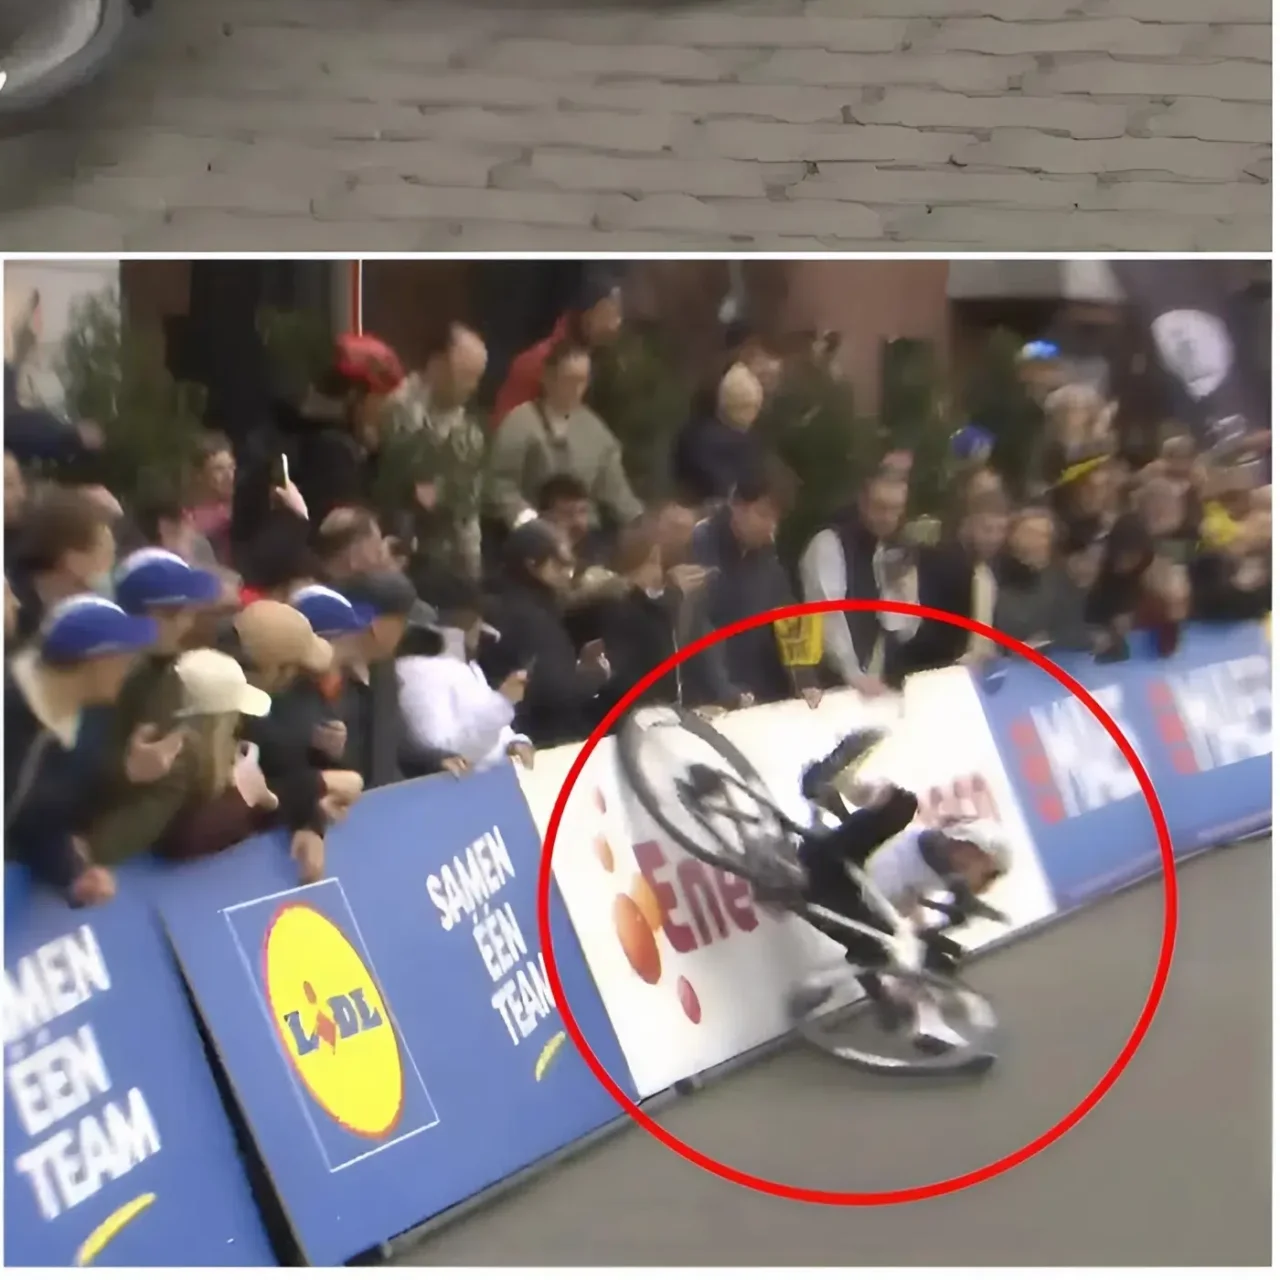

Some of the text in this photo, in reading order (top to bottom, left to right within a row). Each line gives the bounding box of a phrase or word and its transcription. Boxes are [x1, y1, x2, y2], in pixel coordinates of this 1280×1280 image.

[426, 825, 516, 931] SAMEN
[632, 840, 759, 953] Ene
[4, 924, 111, 1046] MEN
[14, 1086, 162, 1221] TEAM
